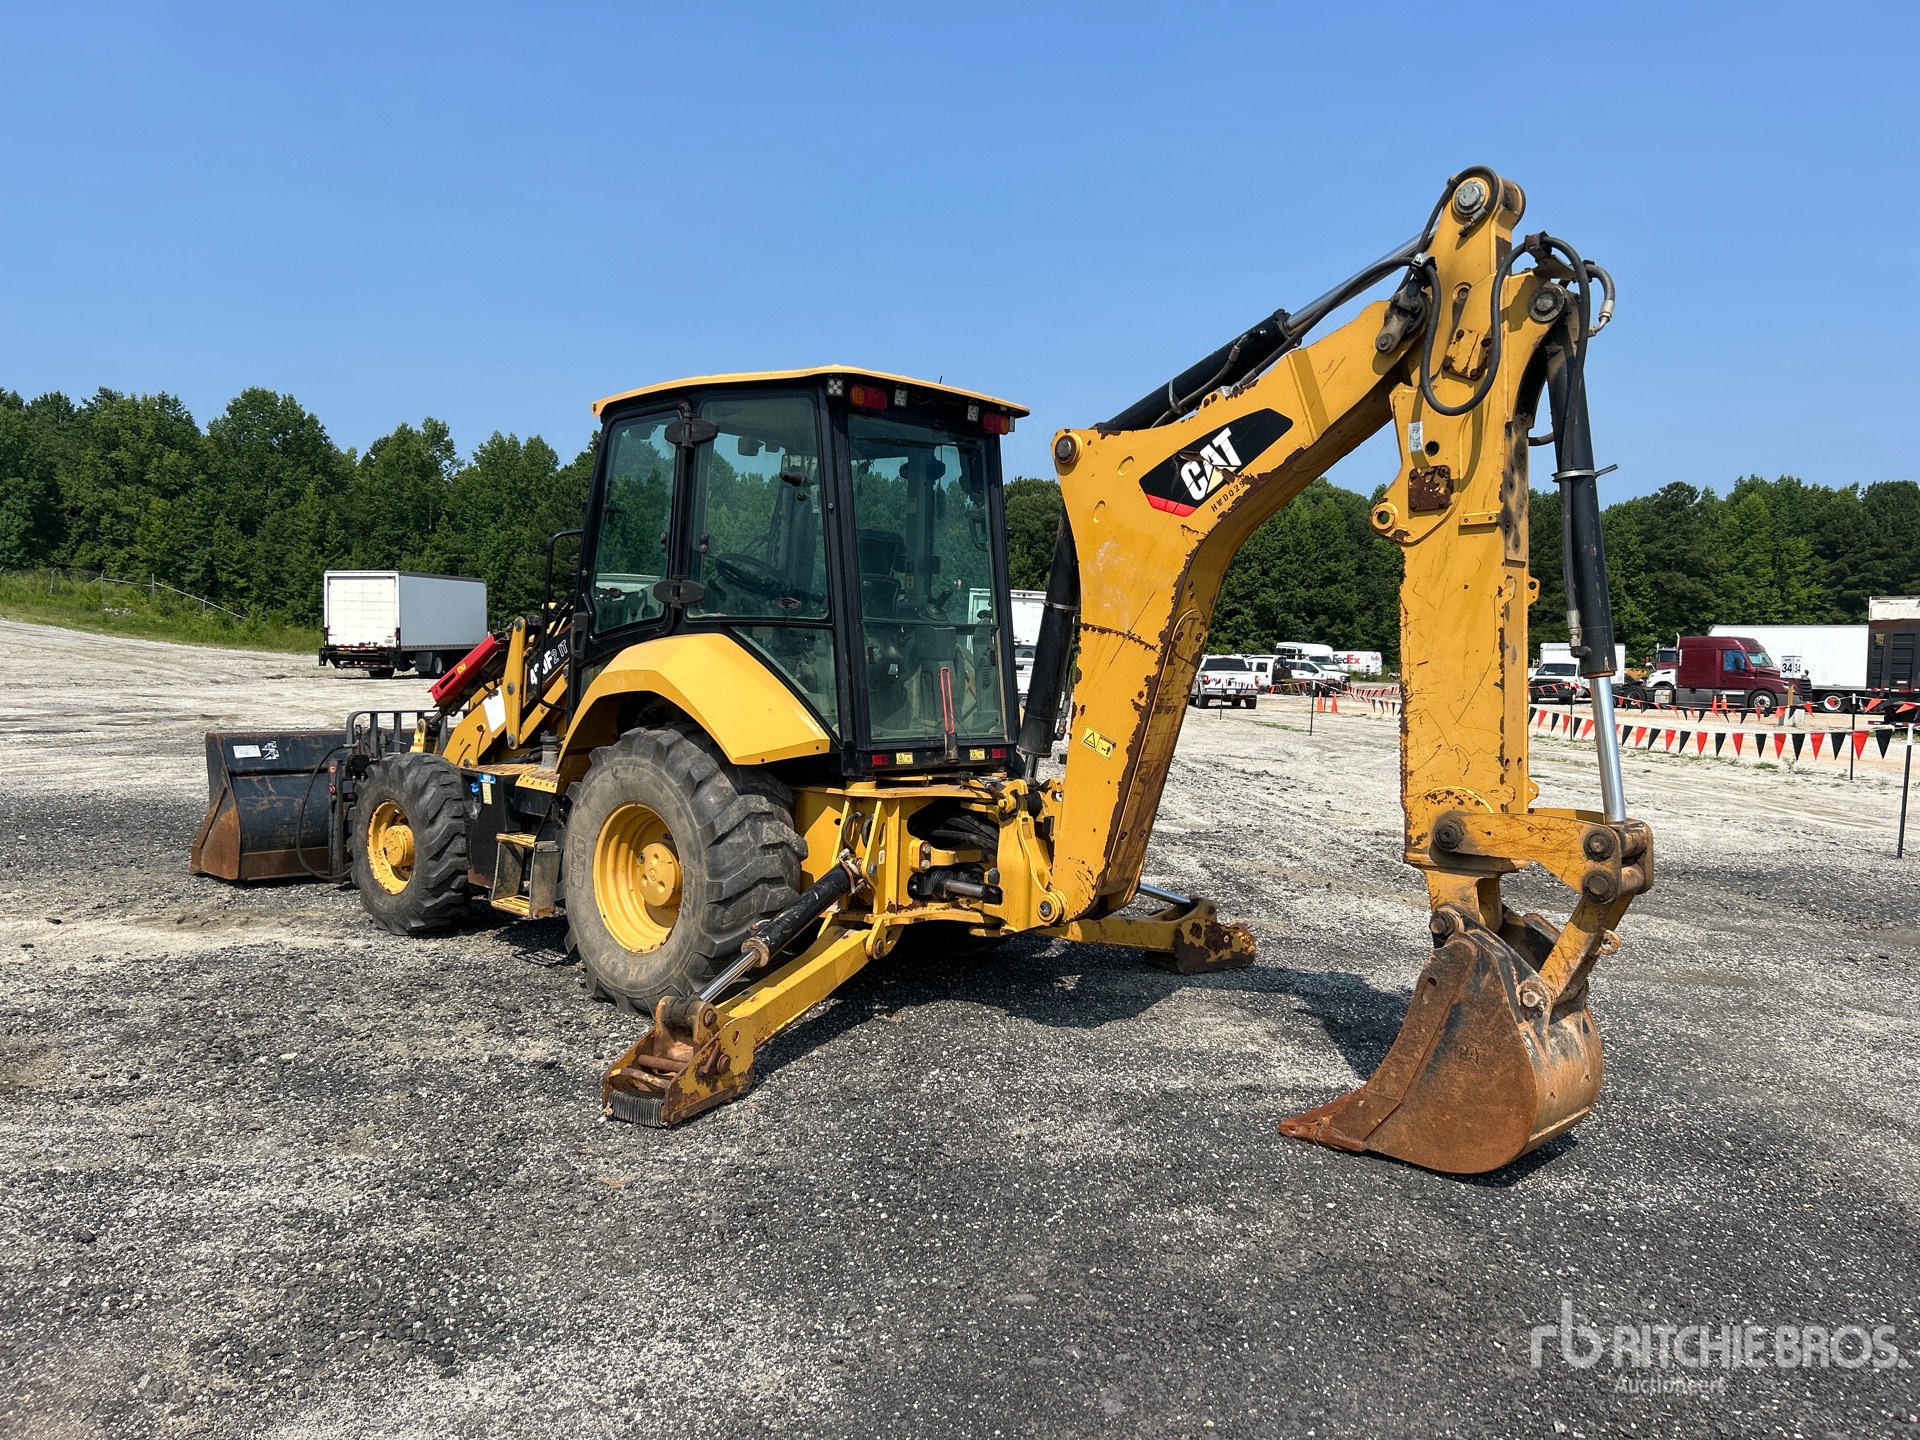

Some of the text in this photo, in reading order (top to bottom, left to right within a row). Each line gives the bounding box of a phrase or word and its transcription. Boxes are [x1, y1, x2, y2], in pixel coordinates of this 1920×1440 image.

[1181, 427, 1242, 500] CAT
[1333, 654, 1360, 665] FedEx
[1782, 663, 1792, 673] 34
[1794, 663, 1801, 673] 34
